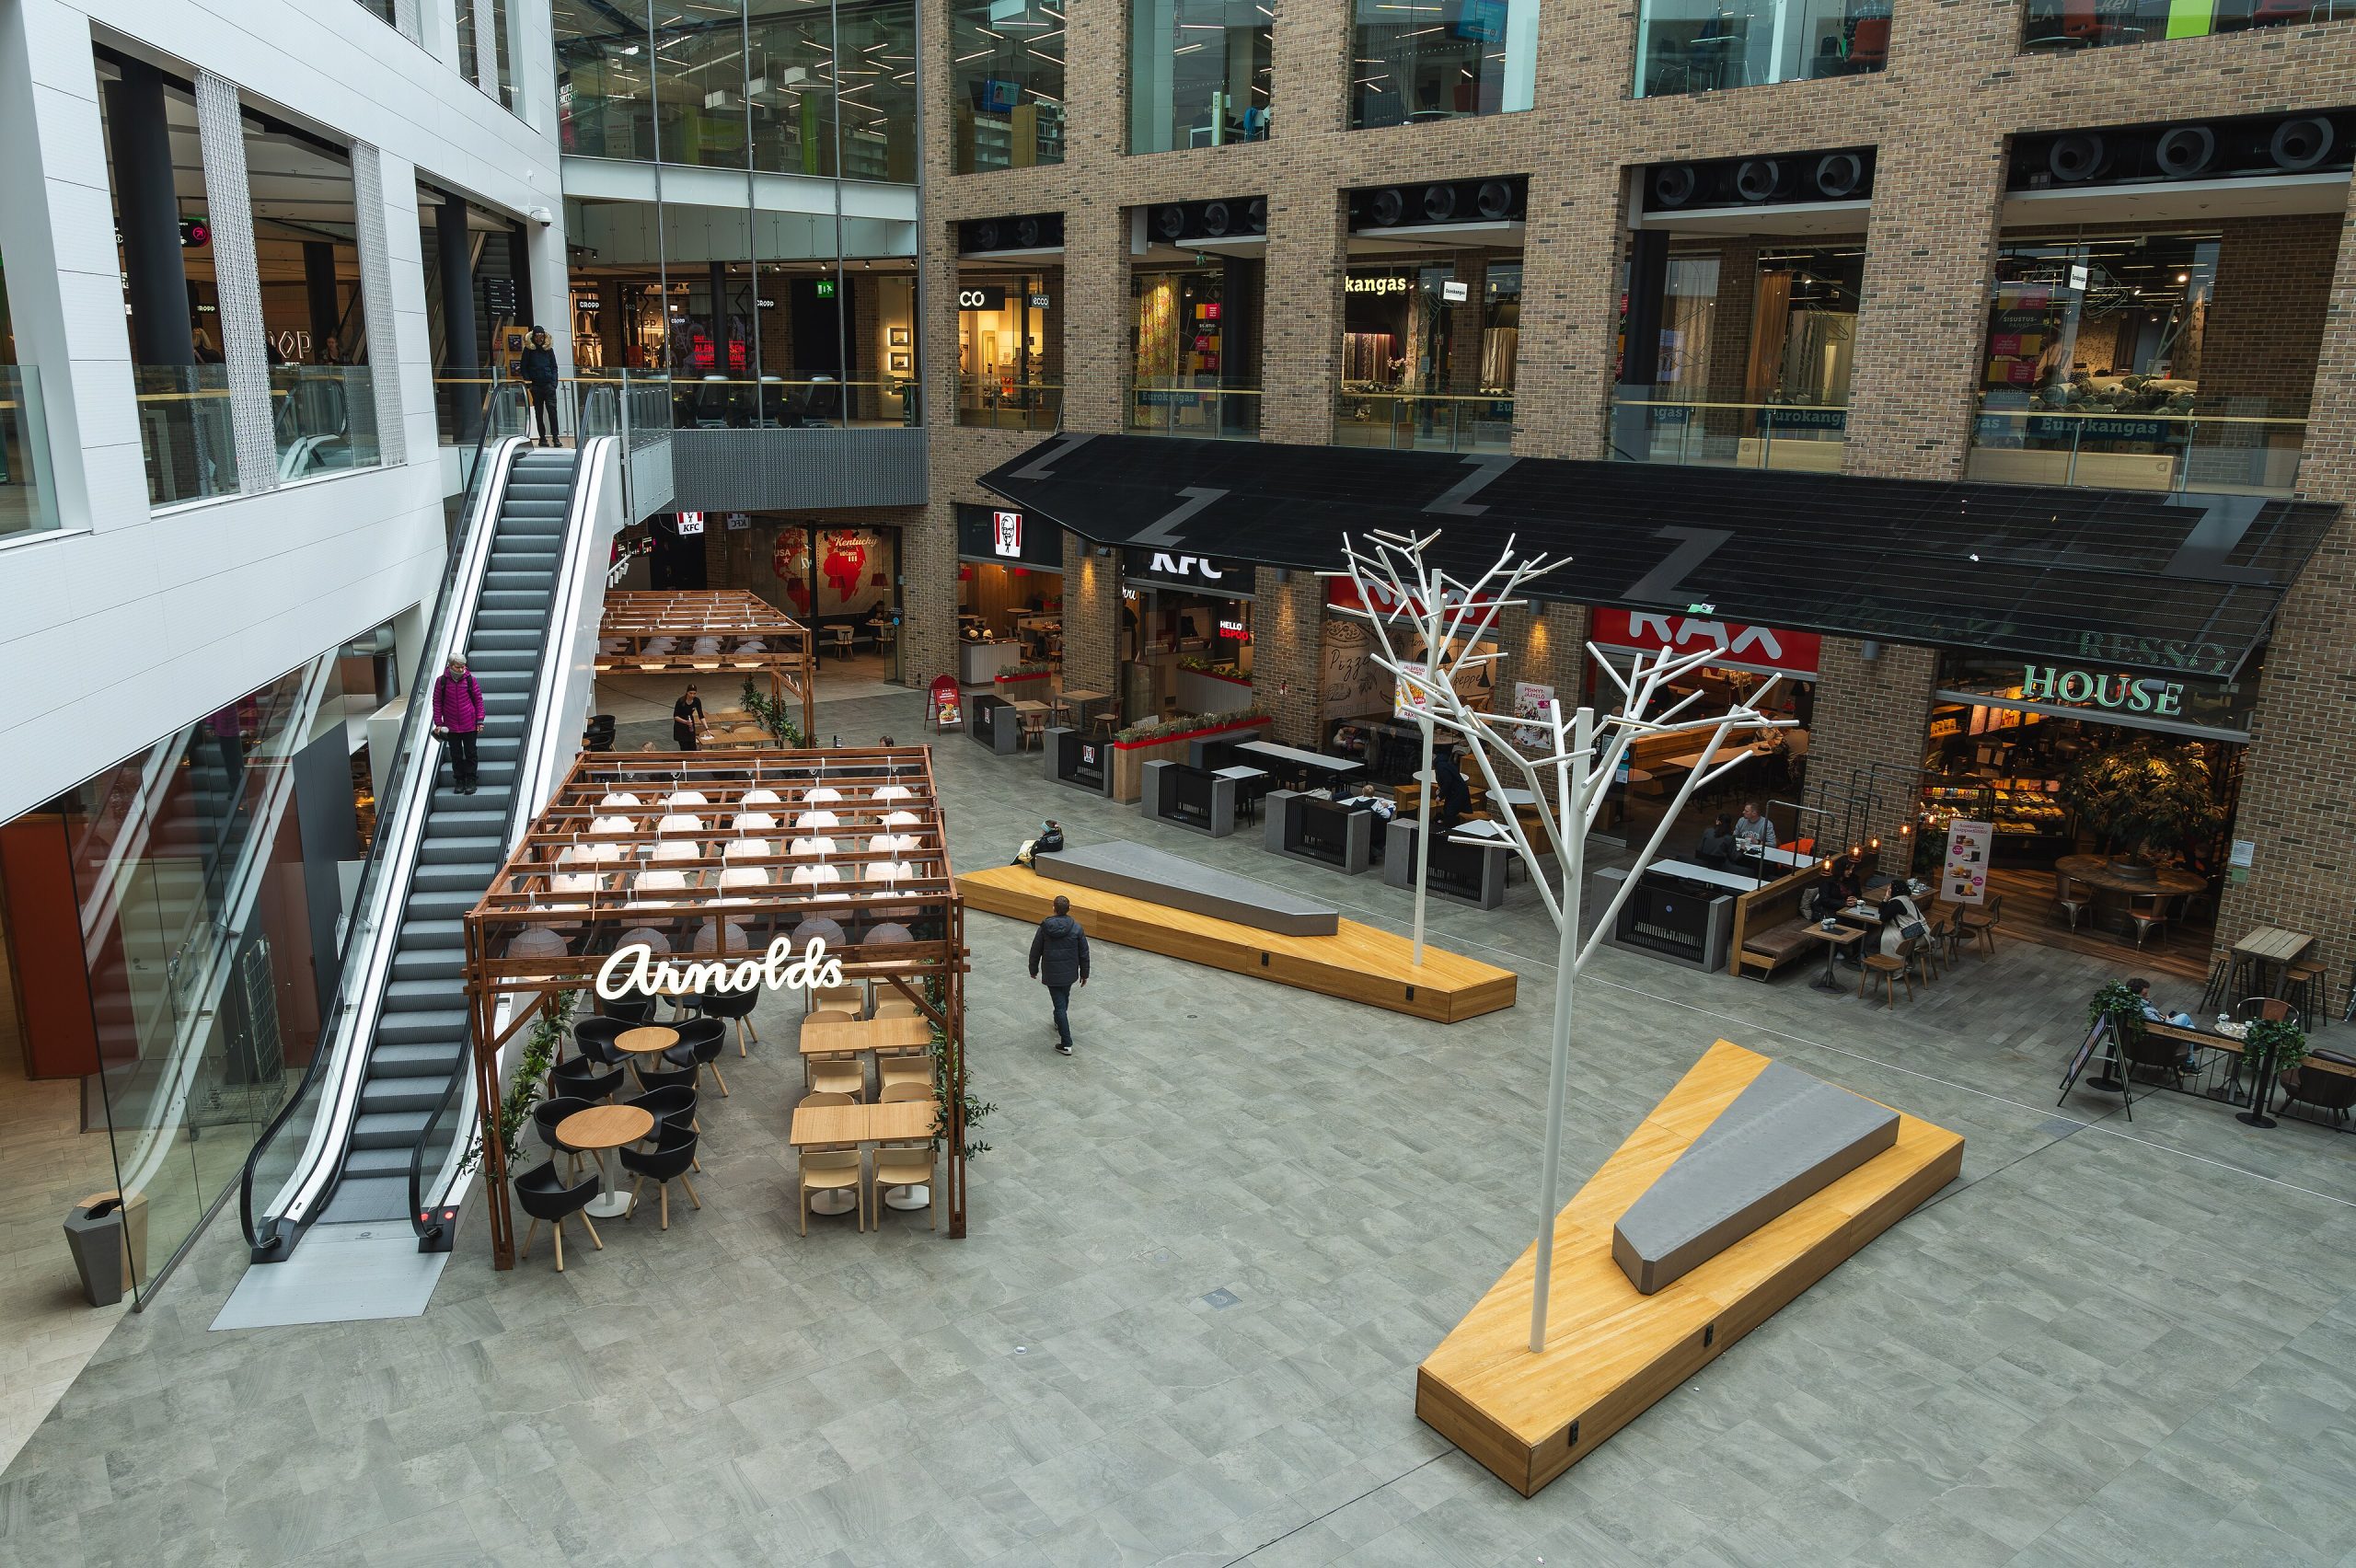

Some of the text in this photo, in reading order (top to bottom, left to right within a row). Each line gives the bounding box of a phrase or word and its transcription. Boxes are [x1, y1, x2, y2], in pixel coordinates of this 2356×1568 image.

[1345, 276, 1406, 295] kangas
[683, 523, 699, 533] KFC
[835, 536, 878, 548] Kentucky
[1219, 620, 1242, 631] HELLO
[1219, 628, 1249, 641] ESPOO
[2021, 664, 2185, 716] HOUSE
[595, 937, 843, 1000] Arnolds
